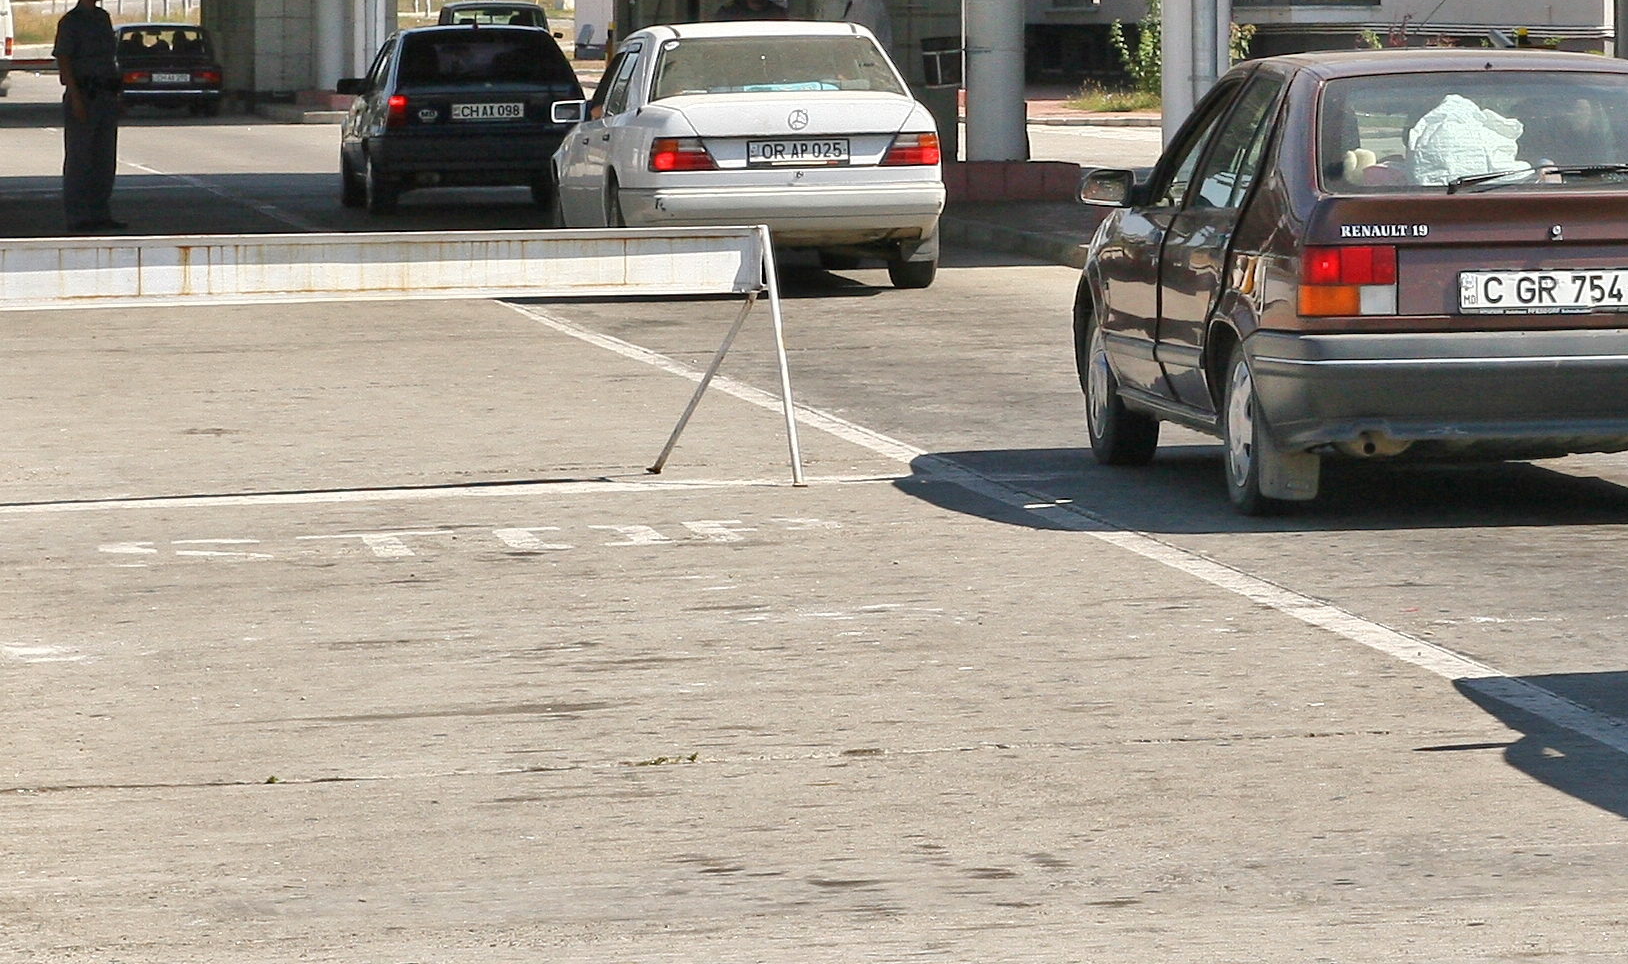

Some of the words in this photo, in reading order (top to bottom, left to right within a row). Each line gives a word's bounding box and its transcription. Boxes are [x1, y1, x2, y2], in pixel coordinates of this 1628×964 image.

[461, 106, 479, 117] CH
[498, 105, 520, 116] 098
[762, 144, 785, 159] OR
[791, 143, 808, 158] AP
[812, 142, 842, 158] 025
[1341, 225, 1408, 237] RENAULT
[1412, 225, 1429, 236] 19
[1483, 276, 1503, 304] C
[1516, 277, 1558, 304] GR
[1571, 275, 1624, 303] 754
